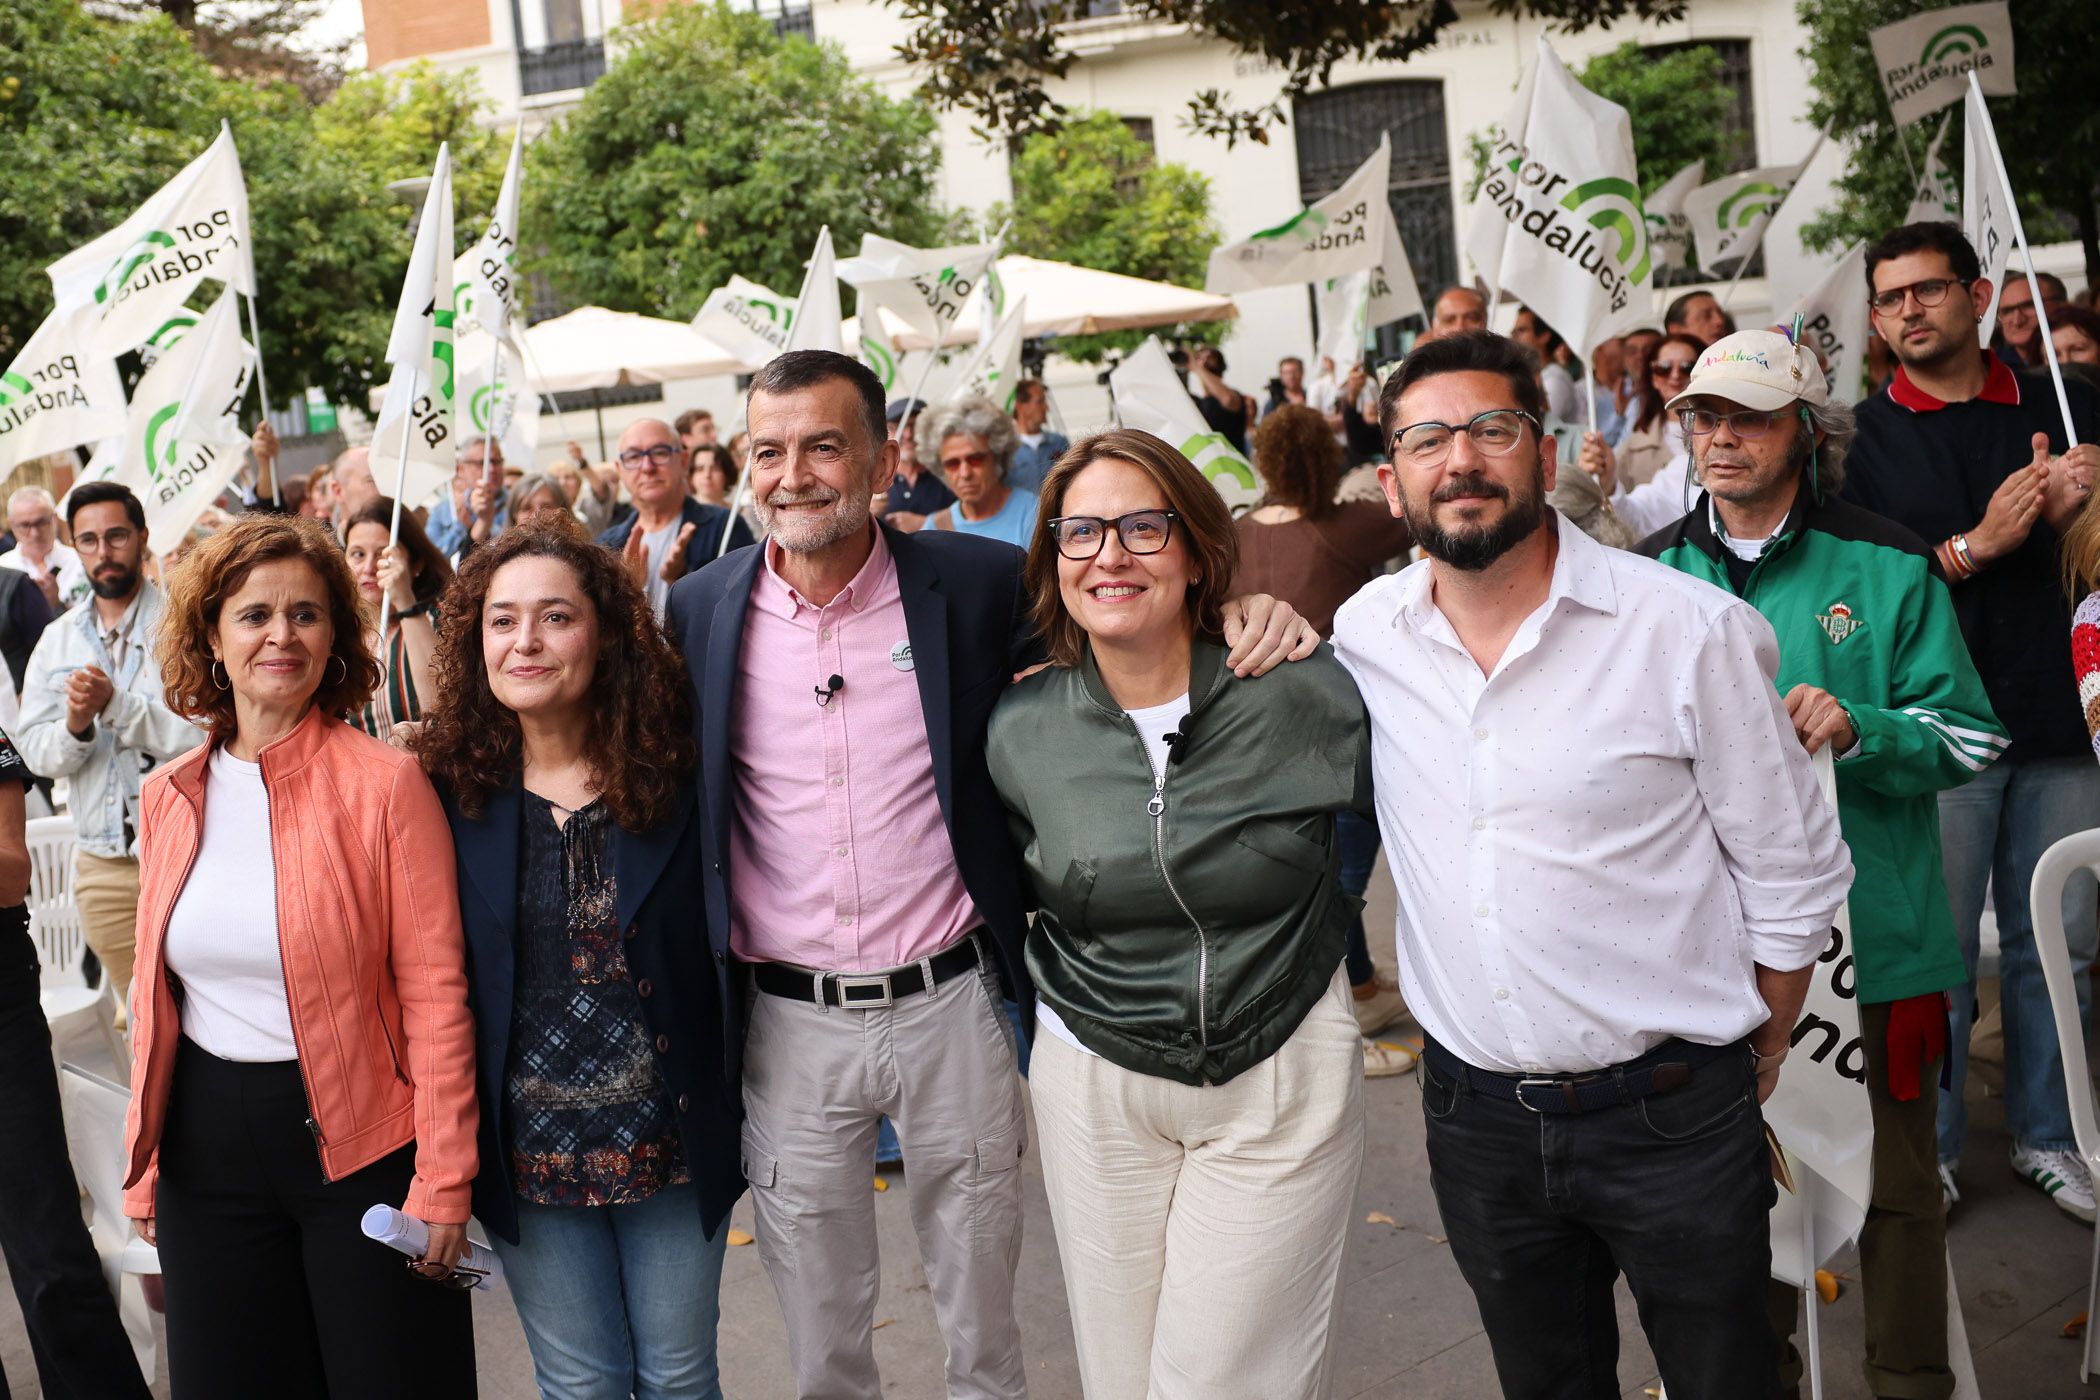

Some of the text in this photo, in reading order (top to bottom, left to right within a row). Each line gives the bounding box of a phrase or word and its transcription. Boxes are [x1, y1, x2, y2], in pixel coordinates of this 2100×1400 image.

[1519, 153, 1568, 197] or
[487, 221, 514, 250] or
[1505, 197, 1628, 314] ndalucía
